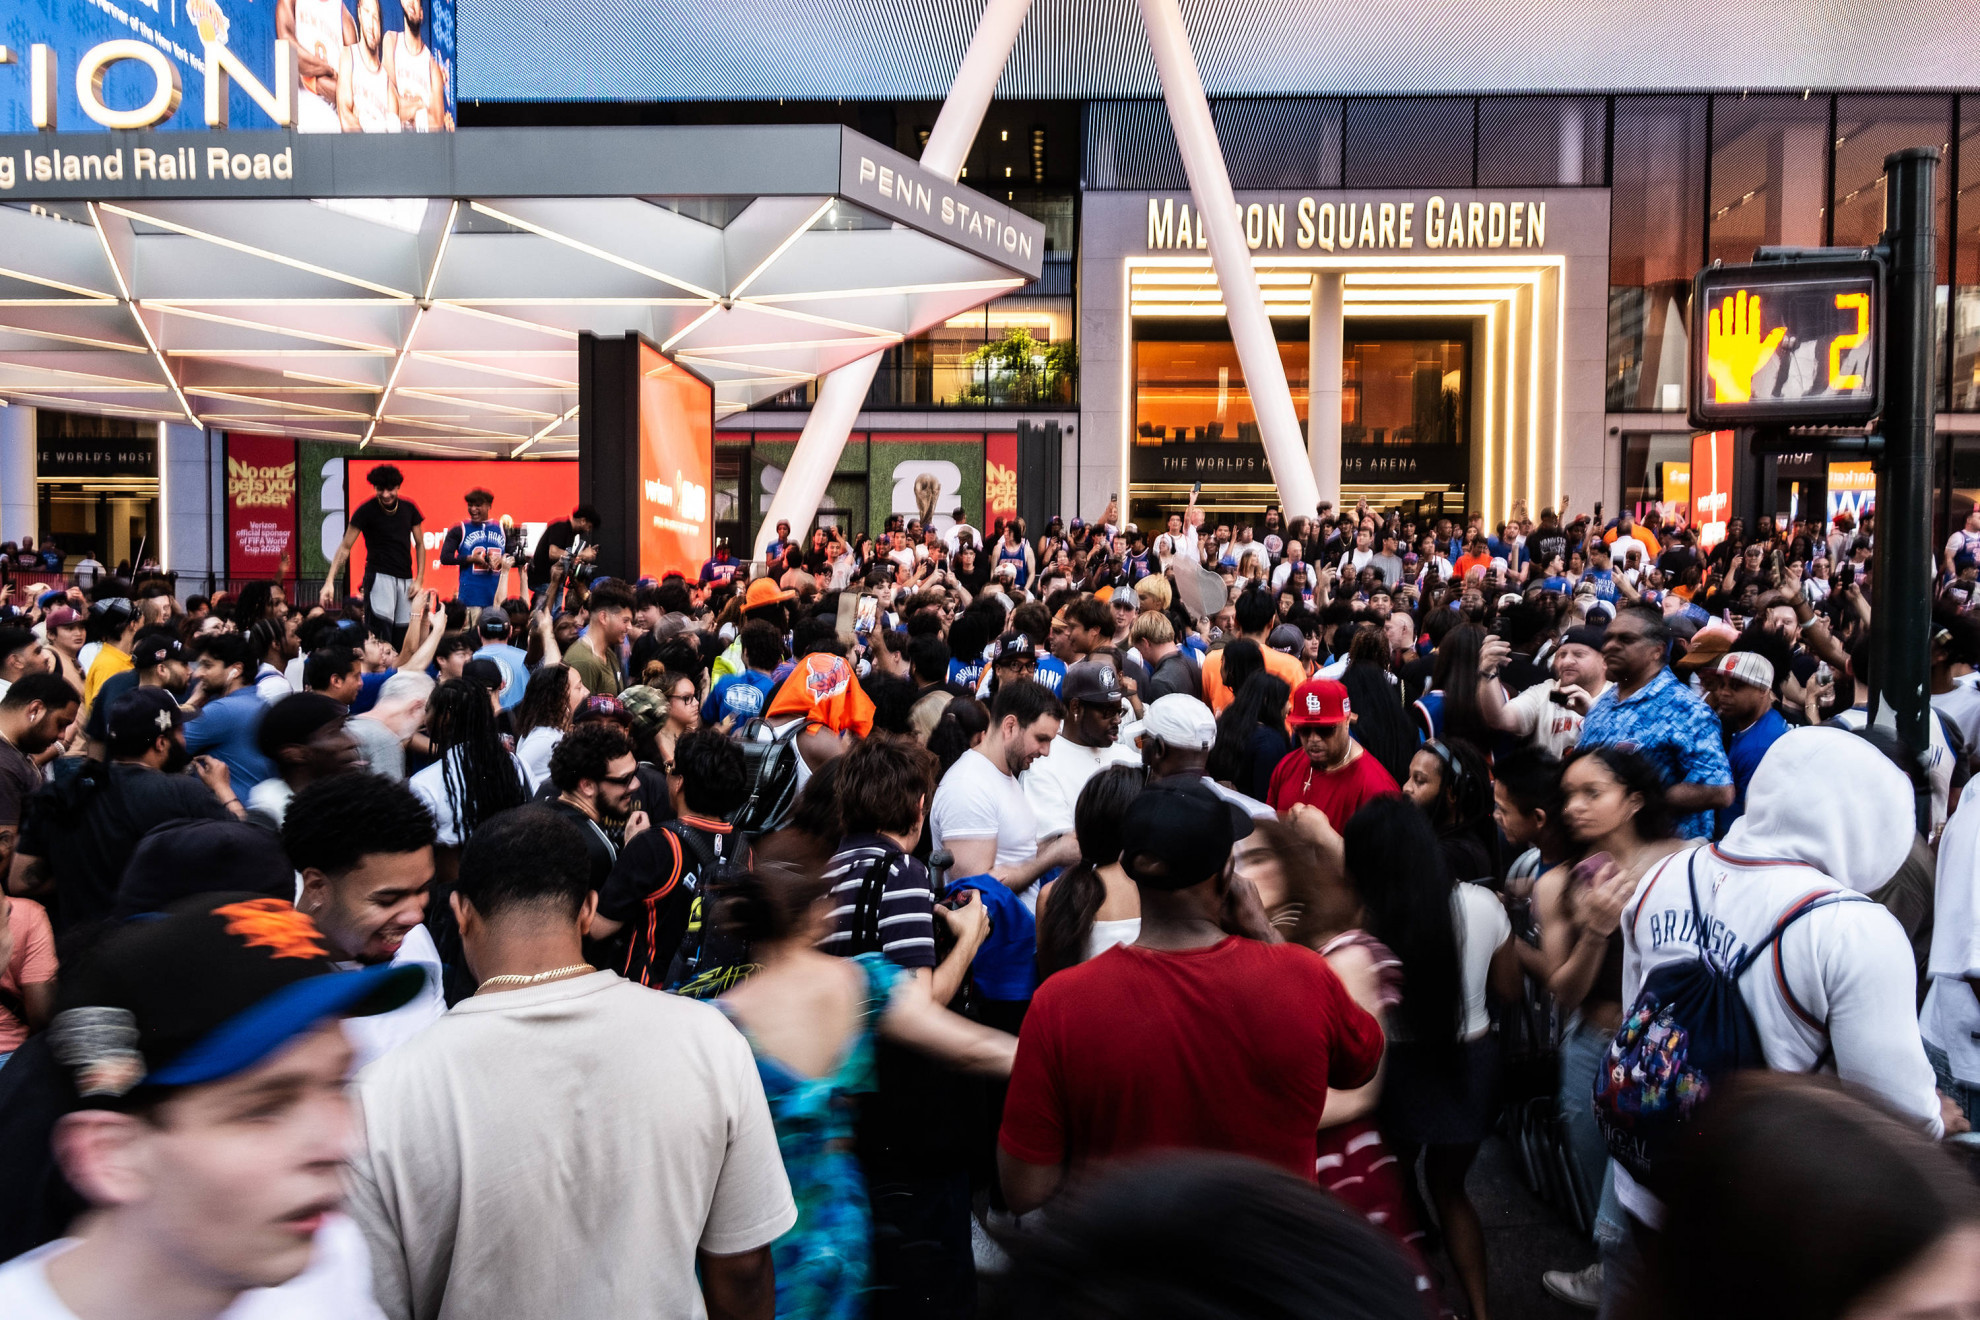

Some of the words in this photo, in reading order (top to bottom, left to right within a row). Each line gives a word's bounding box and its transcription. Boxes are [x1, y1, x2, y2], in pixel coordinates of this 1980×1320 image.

[25, 148, 124, 181] Island
[133, 147, 196, 181] Rail
[206, 147, 294, 181] Road
[860, 156, 932, 216] PENN
[941, 196, 1032, 261] STATION
[1297, 196, 1414, 253] SQUARE
[1425, 195, 1546, 249] GARDEN
[1829, 293, 1869, 389] 2
[56, 452, 111, 463] WORLD'S
[118, 452, 152, 463] MOST
[1163, 457, 1188, 469] THE
[1195, 457, 1255, 469] WORLD'S
[1370, 458, 1417, 469] ARENA
[229, 456, 259, 479] No
[259, 461, 295, 479] one
[986, 459, 1017, 482] No
[229, 478, 265, 495] gets
[264, 478, 295, 495] you
[236, 491, 291, 508] closer
[250, 521, 278, 530] Verizon
[236, 529, 261, 538] official
[261, 530, 291, 540] sponsor
[239, 538, 247, 546] of
[248, 538, 265, 546] FIFA
[265, 538, 287, 546] World
[245, 545, 259, 555] Cup
